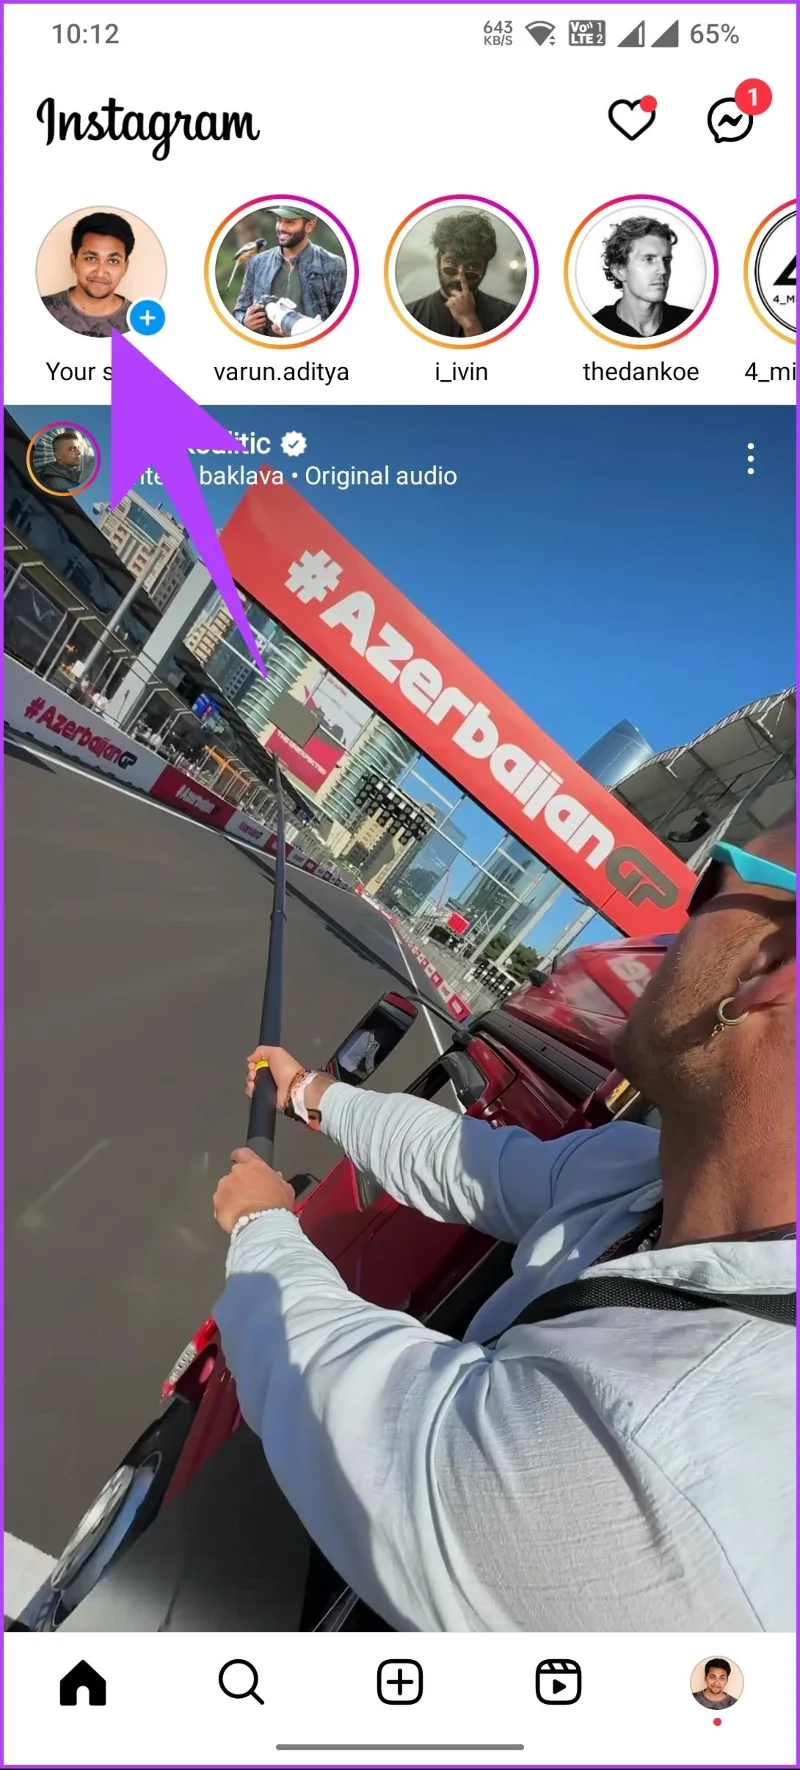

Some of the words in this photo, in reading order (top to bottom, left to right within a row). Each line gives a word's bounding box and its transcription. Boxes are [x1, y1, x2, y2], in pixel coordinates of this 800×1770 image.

[52, 24, 119, 45] 10:12
[483, 20, 513, 34] 643
[690, 23, 740, 45] 65%
[483, 35, 513, 46] KB/S
[571, 34, 594, 45] LTE
[748, 88, 758, 107] 1
[37, 97, 260, 161] Instagram
[46, 362, 96, 381] Your
[214, 361, 349, 386] varun.aditya
[435, 362, 488, 382] i_ivin
[583, 361, 700, 381] thedankoe
[200, 465, 286, 485] baklava
[305, 465, 389, 490] Original
[396, 465, 457, 485] audio
